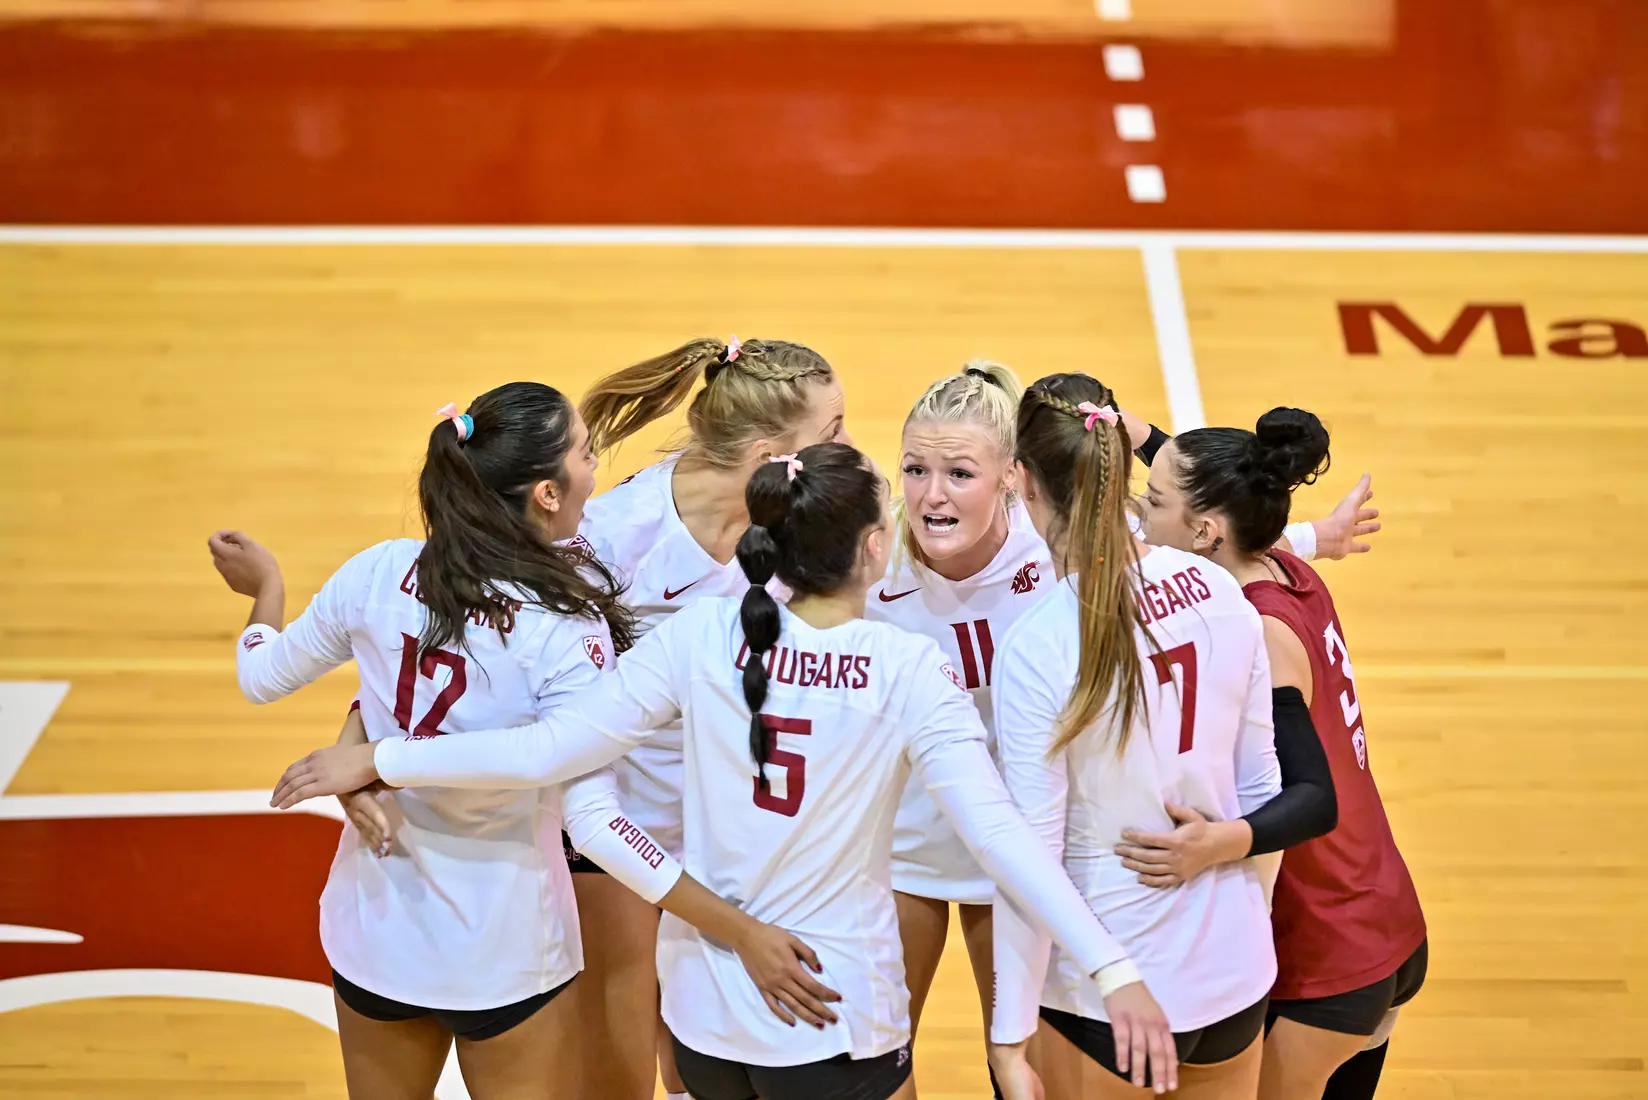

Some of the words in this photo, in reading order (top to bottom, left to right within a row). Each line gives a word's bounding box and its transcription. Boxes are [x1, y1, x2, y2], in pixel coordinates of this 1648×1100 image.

[1336, 301, 1648, 358] Ma
[394, 631, 467, 737] 12
[949, 619, 995, 690] 11
[1147, 641, 1198, 755] 7
[1322, 620, 1361, 728] 3
[752, 713, 812, 817] 5
[608, 816, 665, 870] COUGAR
